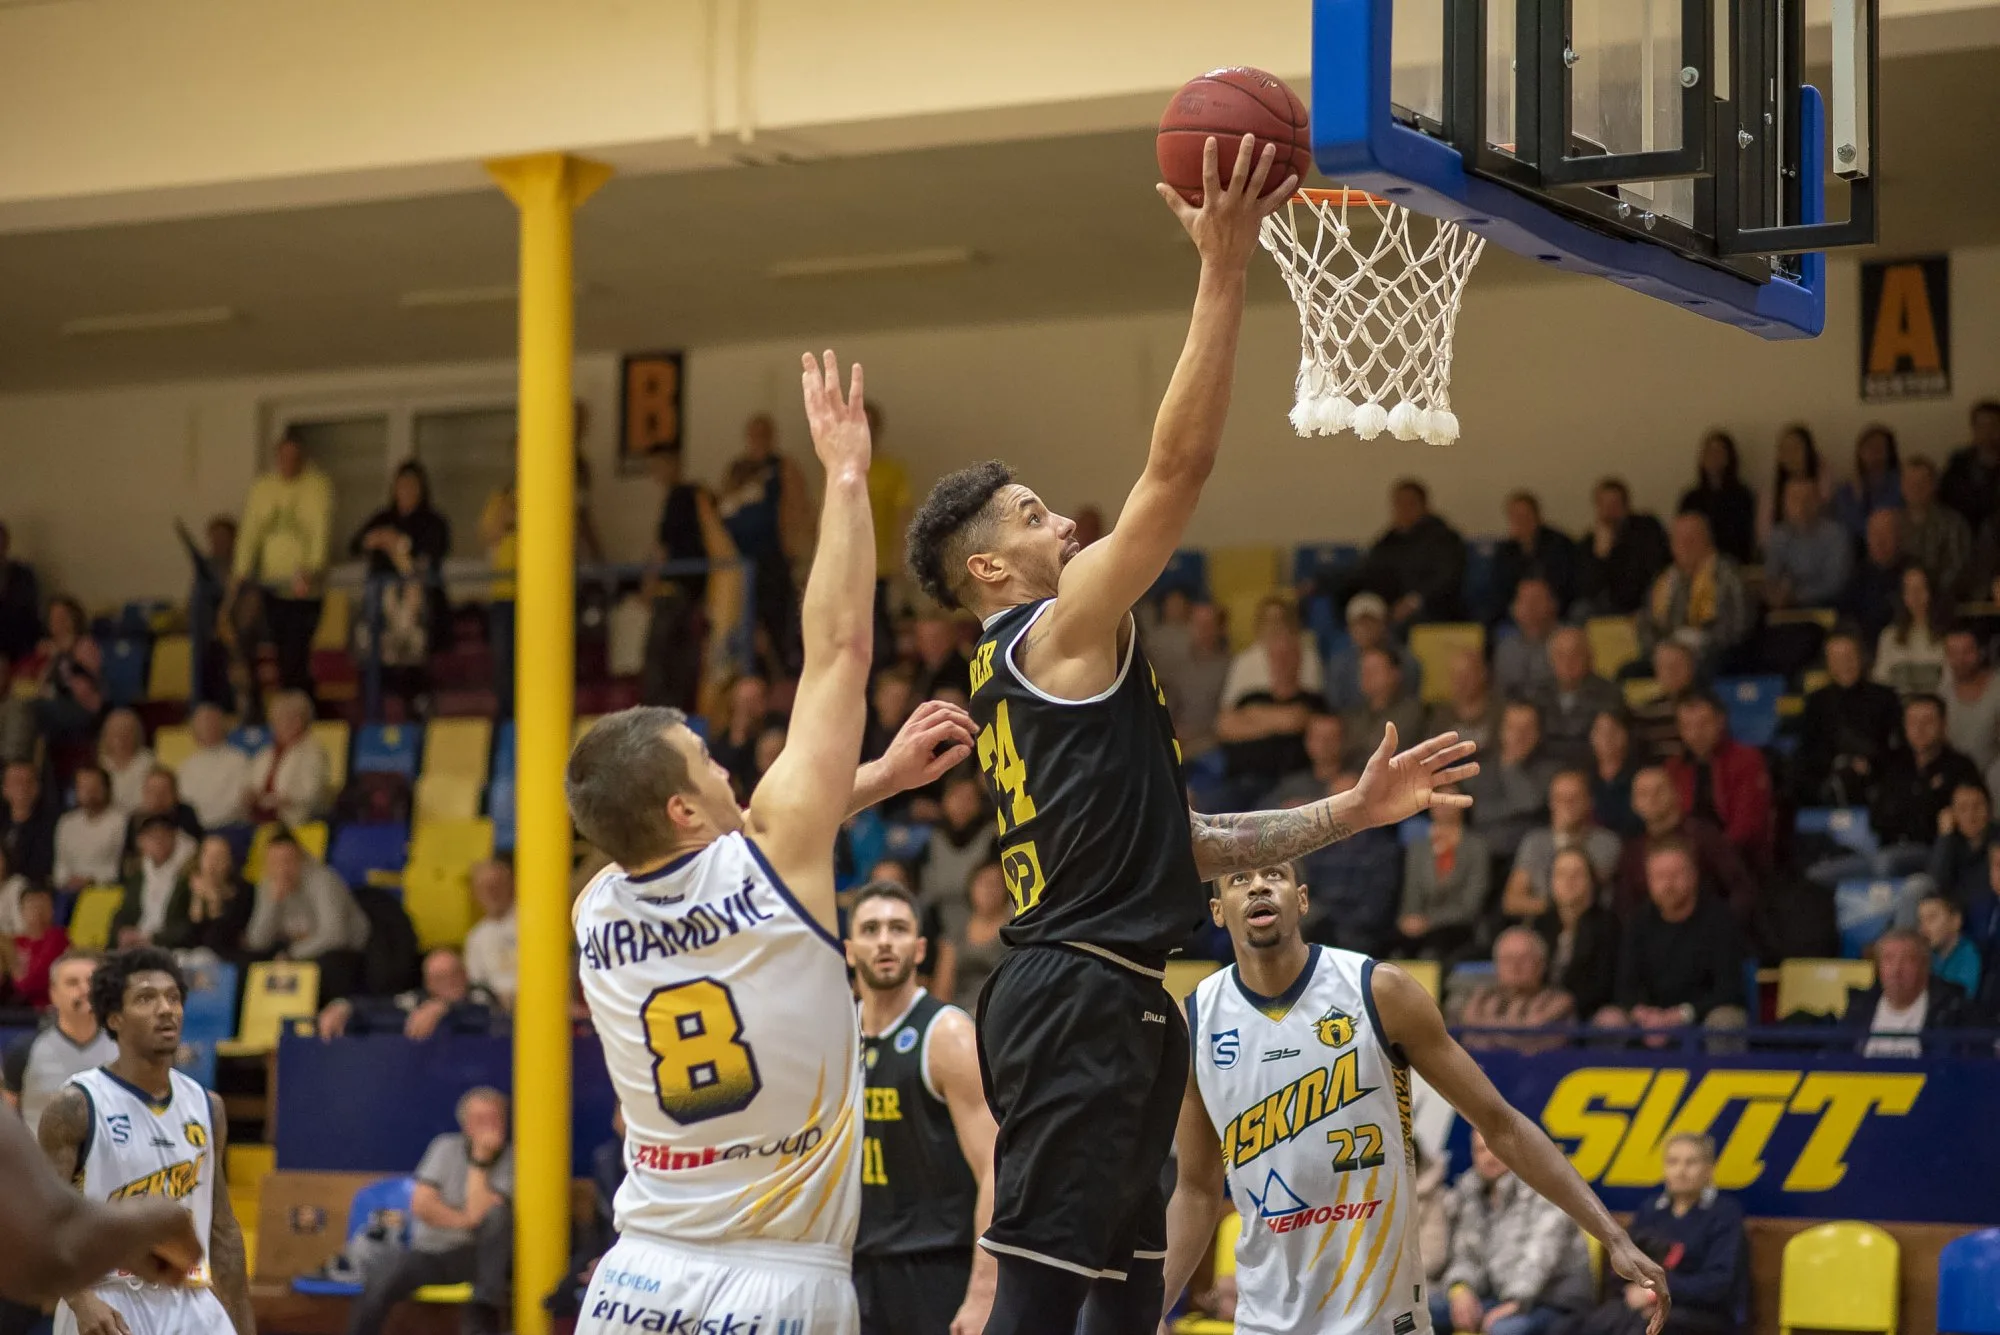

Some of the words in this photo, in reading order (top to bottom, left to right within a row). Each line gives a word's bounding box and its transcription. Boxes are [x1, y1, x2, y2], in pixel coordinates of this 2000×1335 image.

[1868, 264, 1942, 373] A
[627, 360, 677, 452] B
[639, 975, 763, 1126] 8
[1223, 1047, 1381, 1169] ISKRA
[1327, 1123, 1385, 1173] 22
